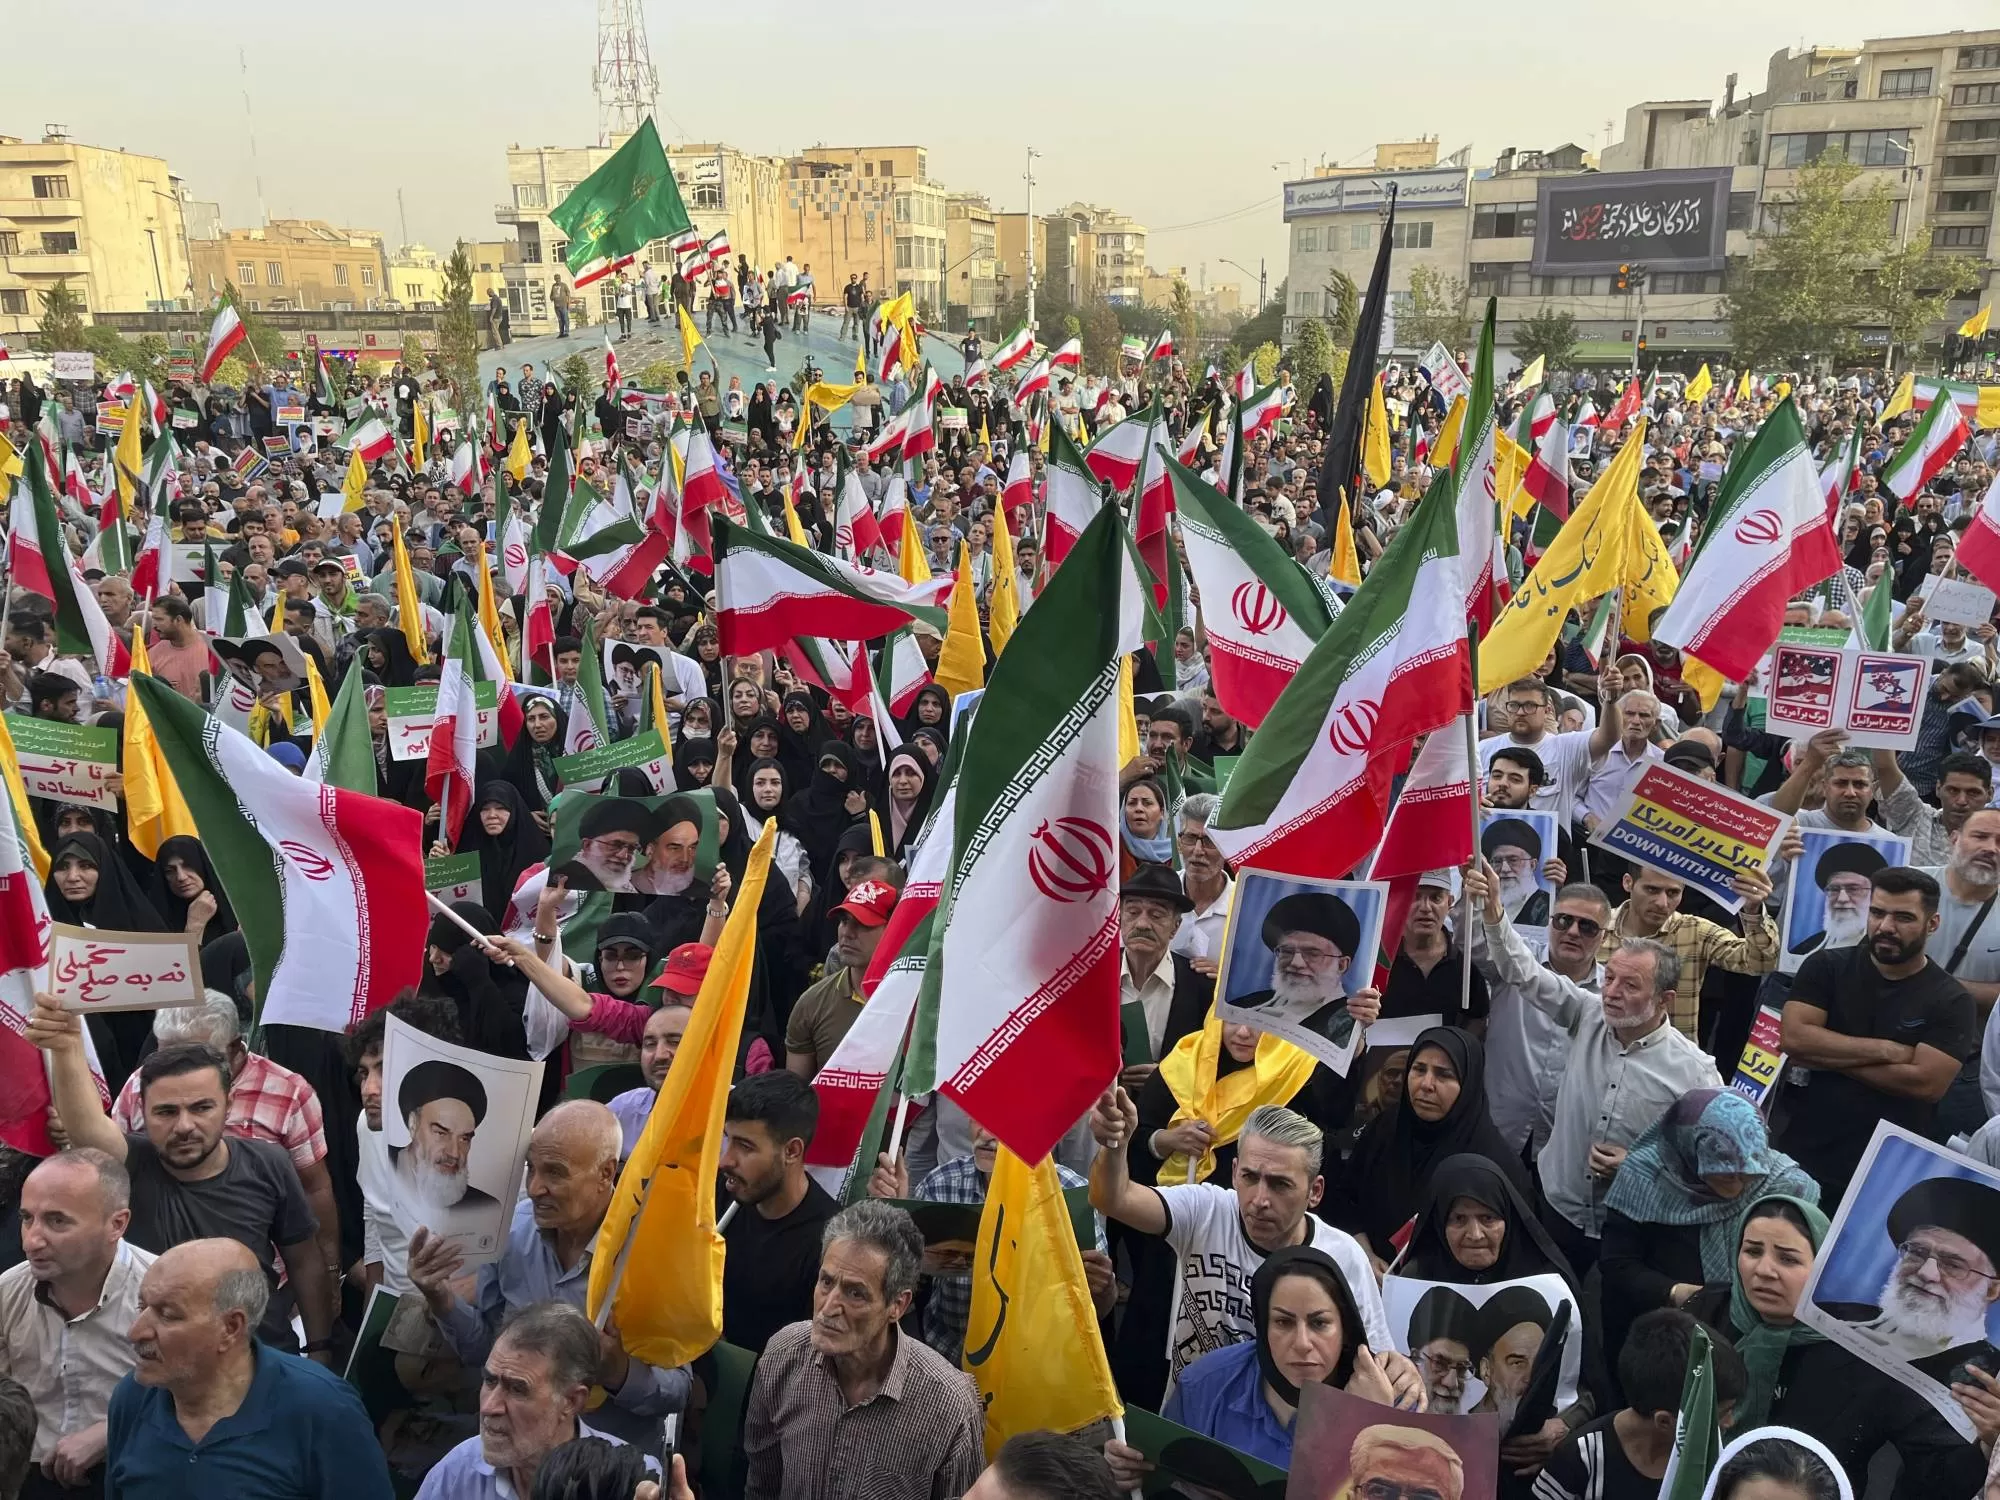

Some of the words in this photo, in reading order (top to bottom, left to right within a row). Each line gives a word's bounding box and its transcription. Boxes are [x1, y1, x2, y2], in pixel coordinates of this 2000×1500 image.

[478, 711, 488, 724] تا
[1776, 704, 1801, 717] آمریکا
[1808, 709, 1826, 722] مرگ
[1891, 719, 1909, 729] مرگ
[18, 759, 78, 777] آخ
[88, 764, 103, 780] تا
[649, 761, 660, 774] تا
[37, 780, 103, 802] ایستاده
[1632, 803, 1702, 841] آمریکا
[1688, 836, 1715, 854] بر
[1611, 827, 1665, 858] DOWN
[1665, 850, 1711, 877] WITH
[1710, 871, 1735, 890] US
[1712, 843, 1762, 869] مرگ
[157, 962, 186, 982] نه
[78, 969, 119, 1002] صلح
[125, 973, 153, 991] به
[1741, 1050, 1775, 1078] مرگ
